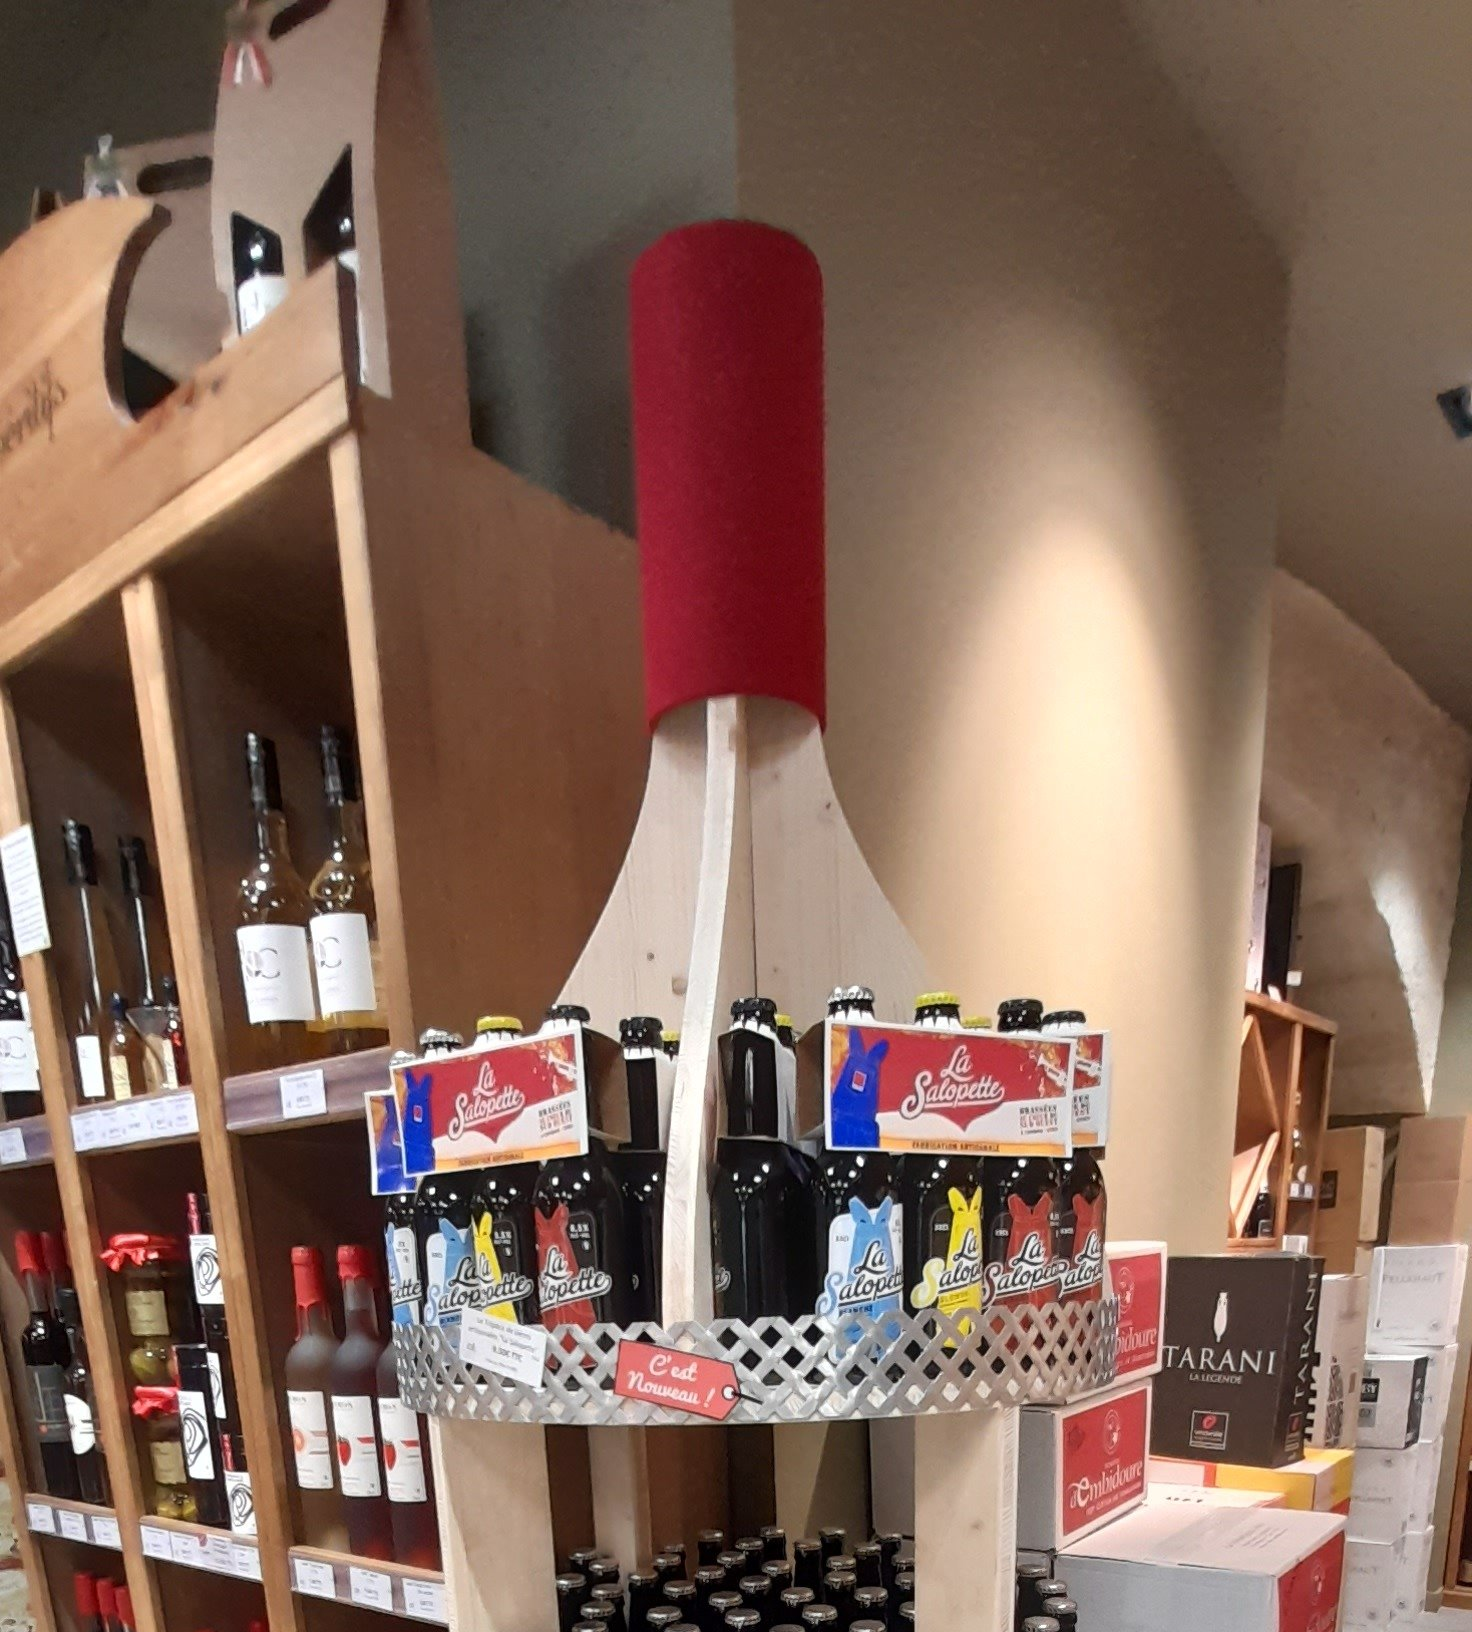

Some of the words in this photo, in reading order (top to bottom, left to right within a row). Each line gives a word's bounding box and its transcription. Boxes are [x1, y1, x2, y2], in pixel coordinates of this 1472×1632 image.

[473, 1061, 498, 1097] La
[940, 1045, 973, 1082] La
[449, 1084, 526, 1141] Salopette
[900, 1071, 1005, 1119] Salopette
[854, 1240, 889, 1275] La
[953, 1228, 979, 1261] La
[1010, 1232, 1045, 1268] La
[1076, 1229, 1100, 1263] La
[449, 1256, 478, 1288] La
[545, 1246, 574, 1281] La
[1294, 1273, 1318, 1404] TARANI
[649, 1354, 698, 1383] C'est
[1162, 1345, 1277, 1376] TARANI
[1188, 1373, 1199, 1382] LA
[627, 1370, 702, 1405] Nouveau
